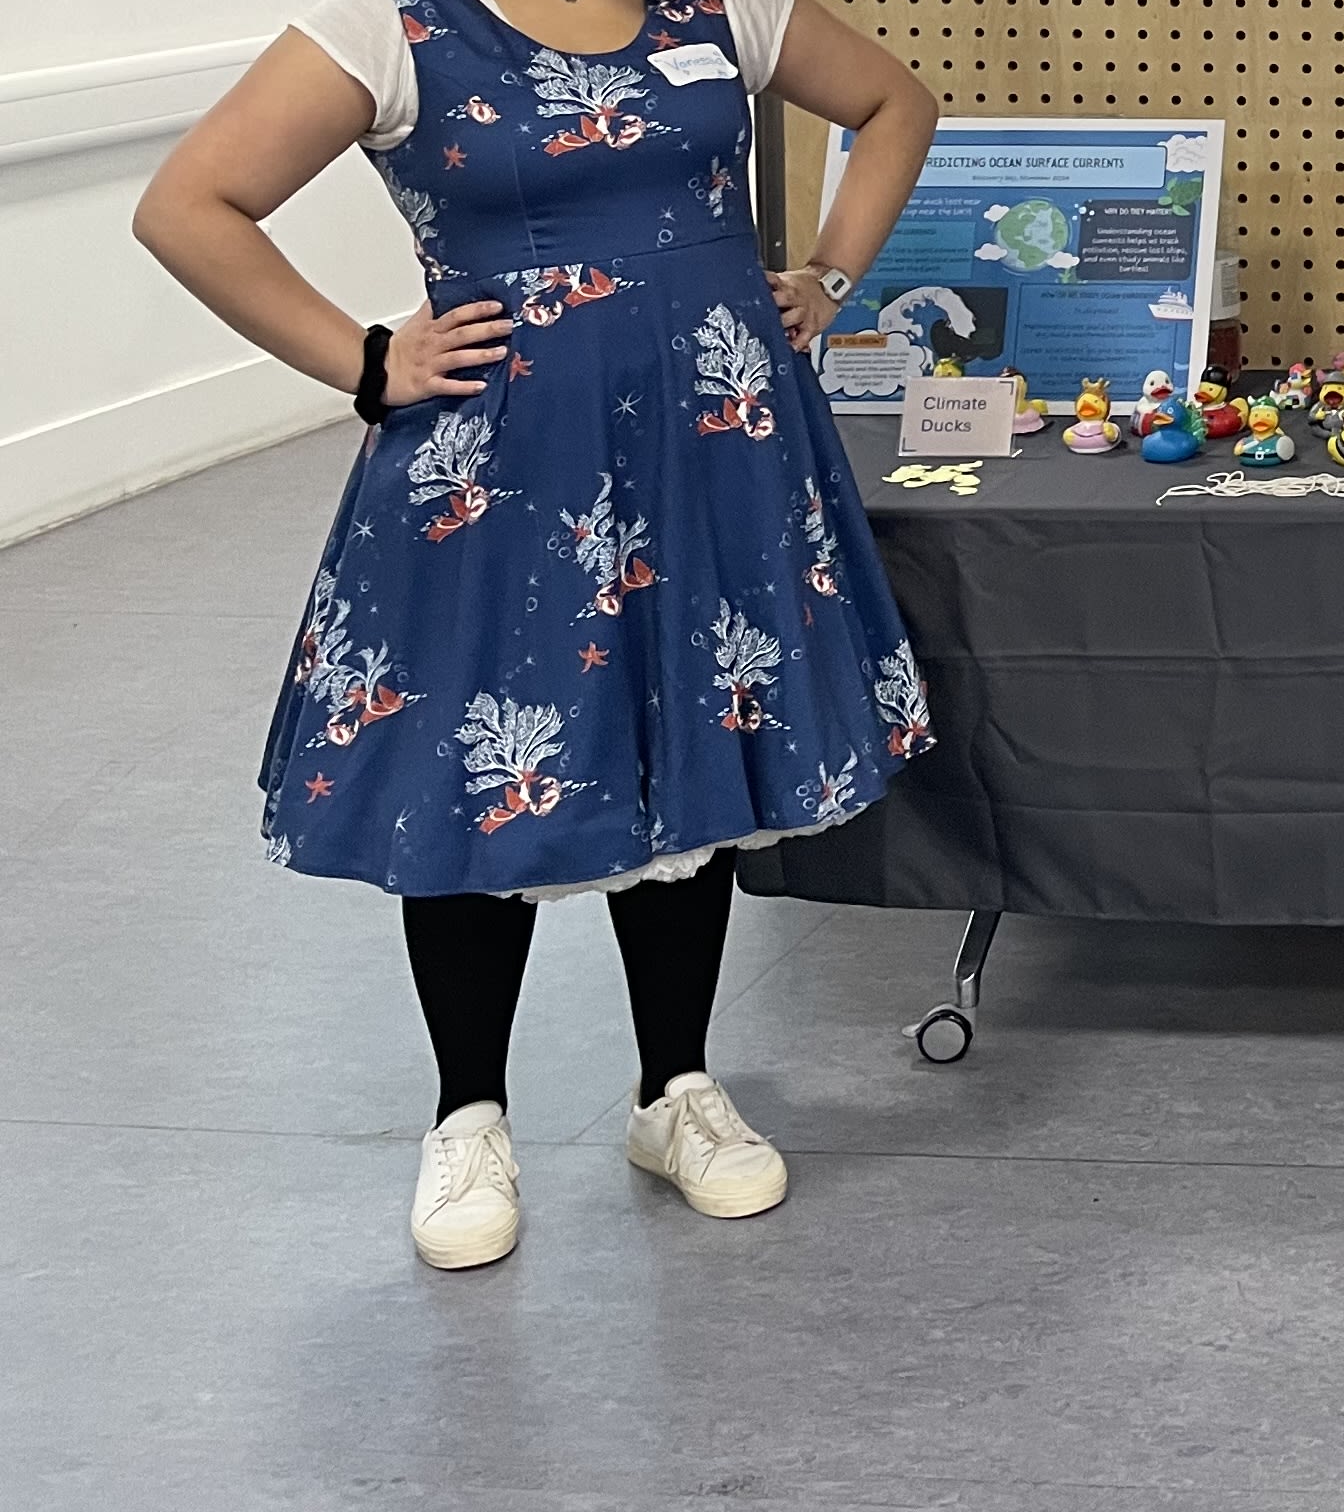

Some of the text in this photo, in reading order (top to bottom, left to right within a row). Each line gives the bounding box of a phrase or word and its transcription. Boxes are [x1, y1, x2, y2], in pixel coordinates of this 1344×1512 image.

[926, 157, 1125, 170] REDICTING OCEAN SURFACE CURRENTS
[923, 396, 987, 410] Climate
[921, 419, 972, 432] Ducks
